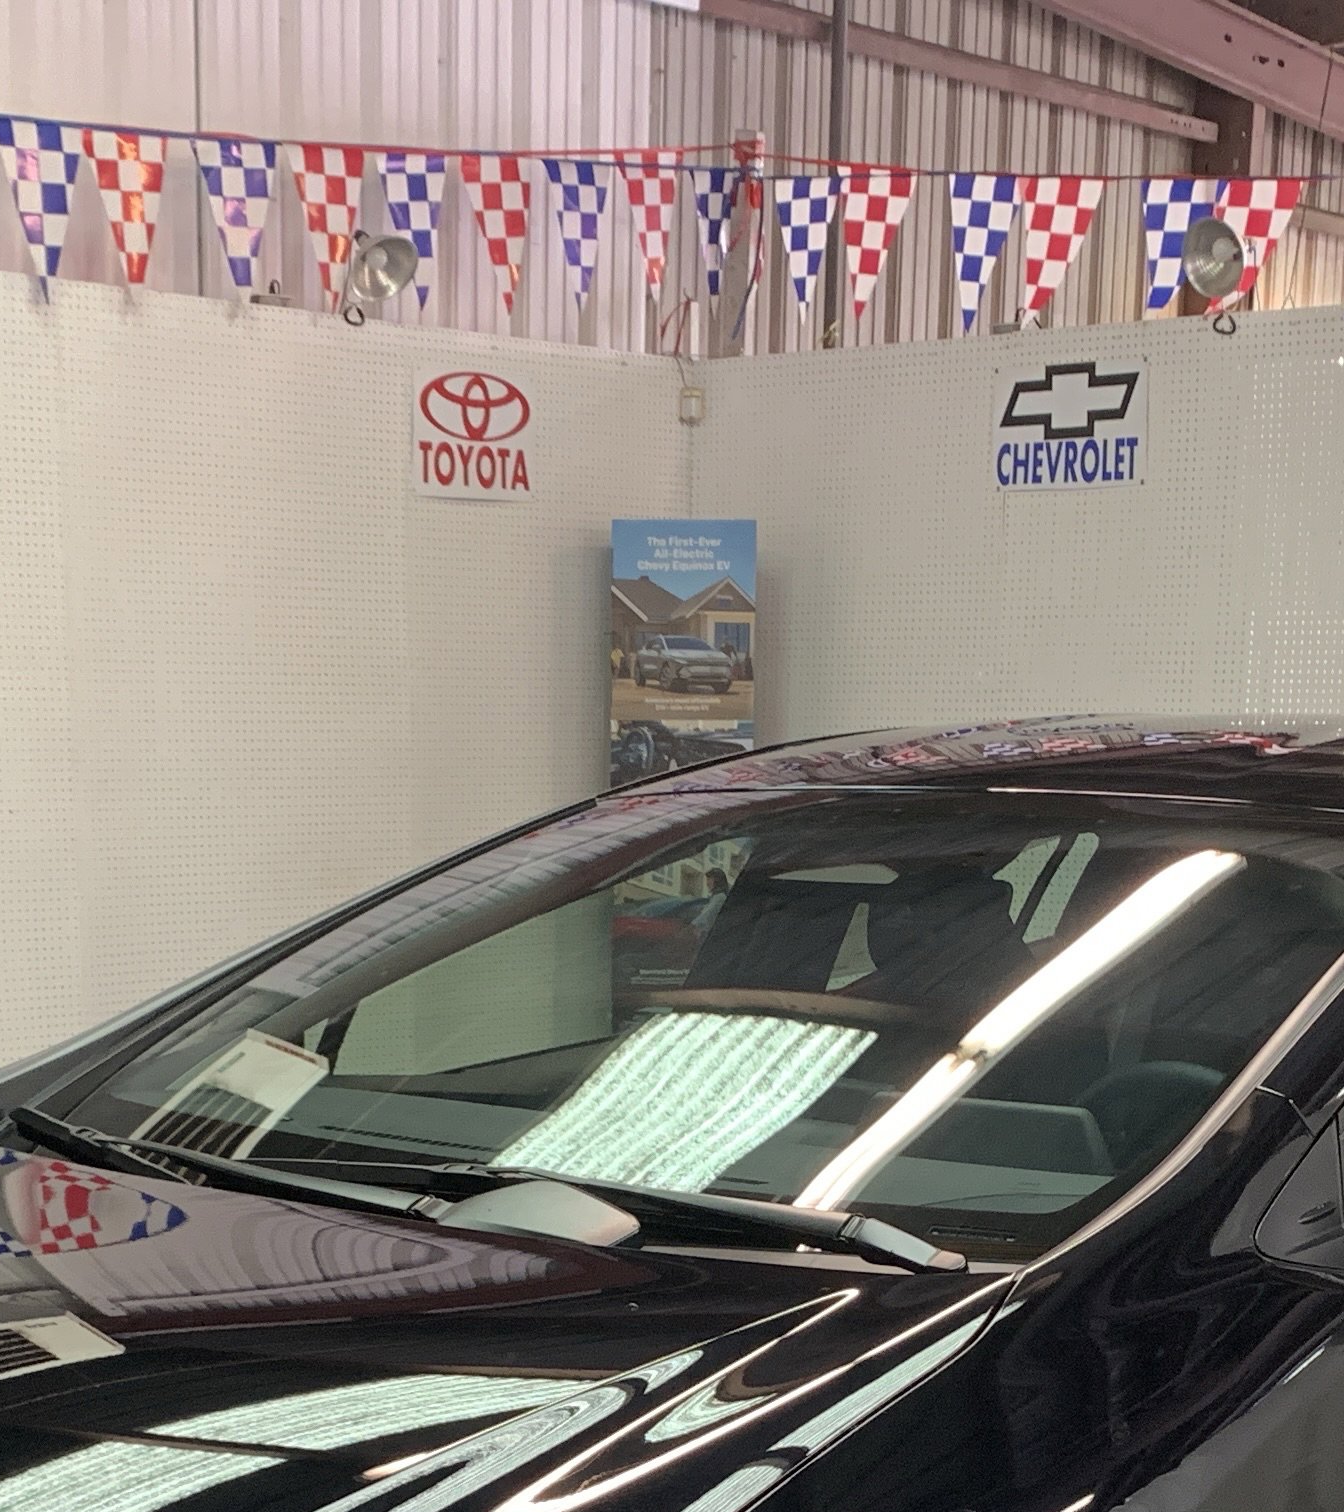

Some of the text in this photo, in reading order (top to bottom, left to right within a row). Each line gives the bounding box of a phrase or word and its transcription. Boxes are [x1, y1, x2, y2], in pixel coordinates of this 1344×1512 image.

[419, 440, 530, 491] TOYOTA
[996, 436, 1138, 486] CHEVROLET
[647, 536, 666, 546] The
[637, 560, 670, 571] Chevy
[716, 561, 731, 570] EV
